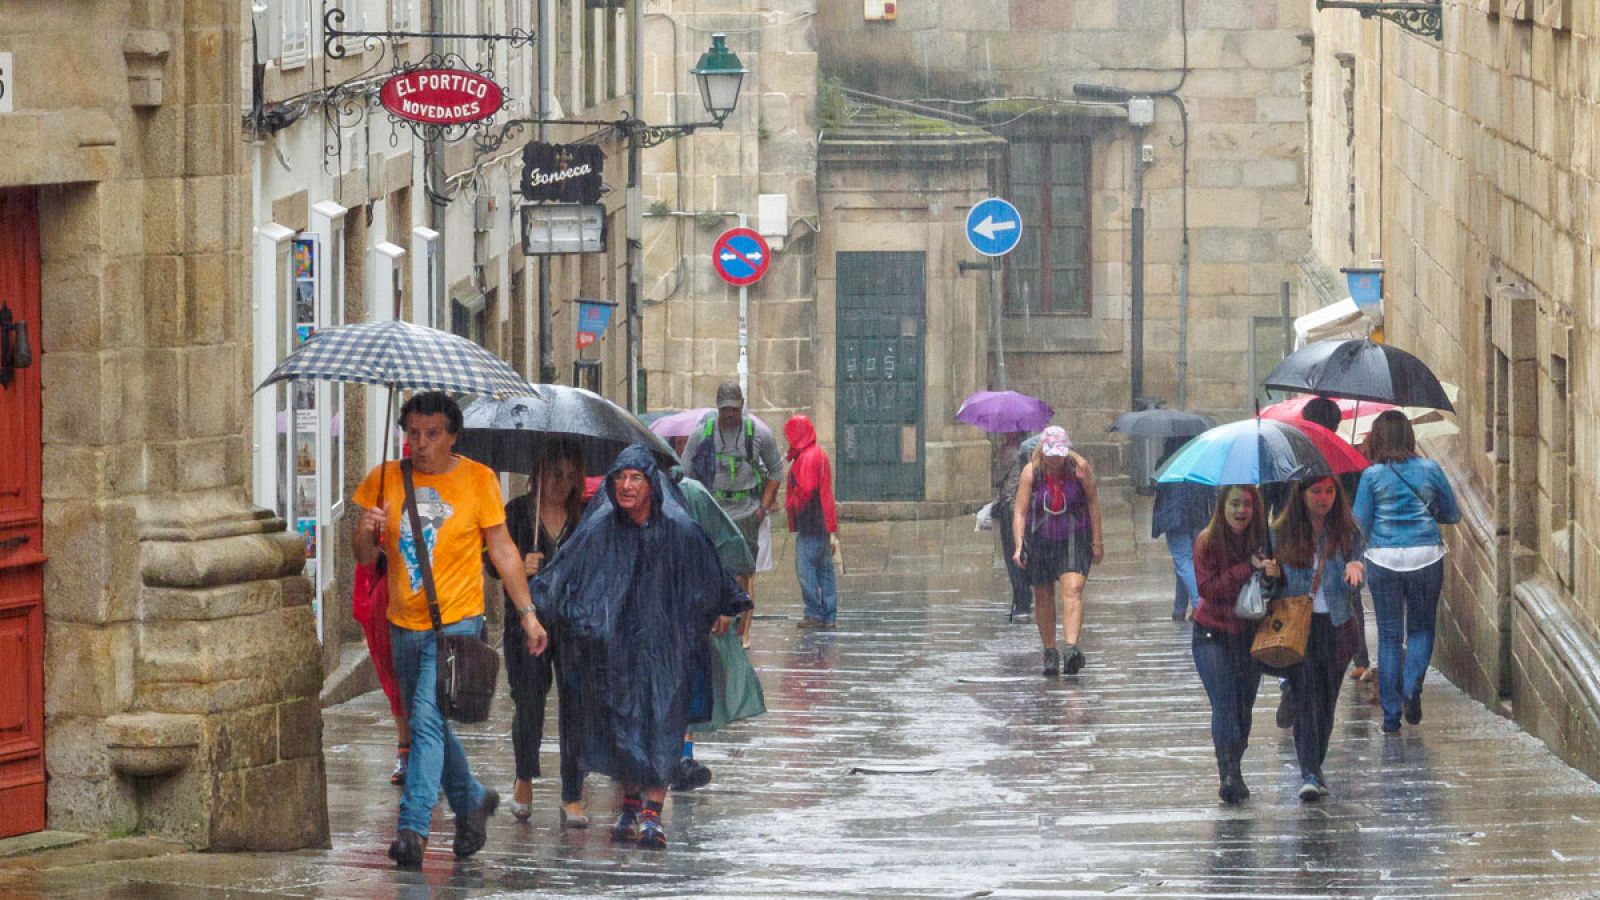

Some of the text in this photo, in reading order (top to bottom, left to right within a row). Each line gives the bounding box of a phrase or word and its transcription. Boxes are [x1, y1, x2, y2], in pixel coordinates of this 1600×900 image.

[396, 74, 487, 99] EL PORTICO
[402, 98, 480, 118] NOVEDADES
[531, 163, 592, 186] Fonseca
